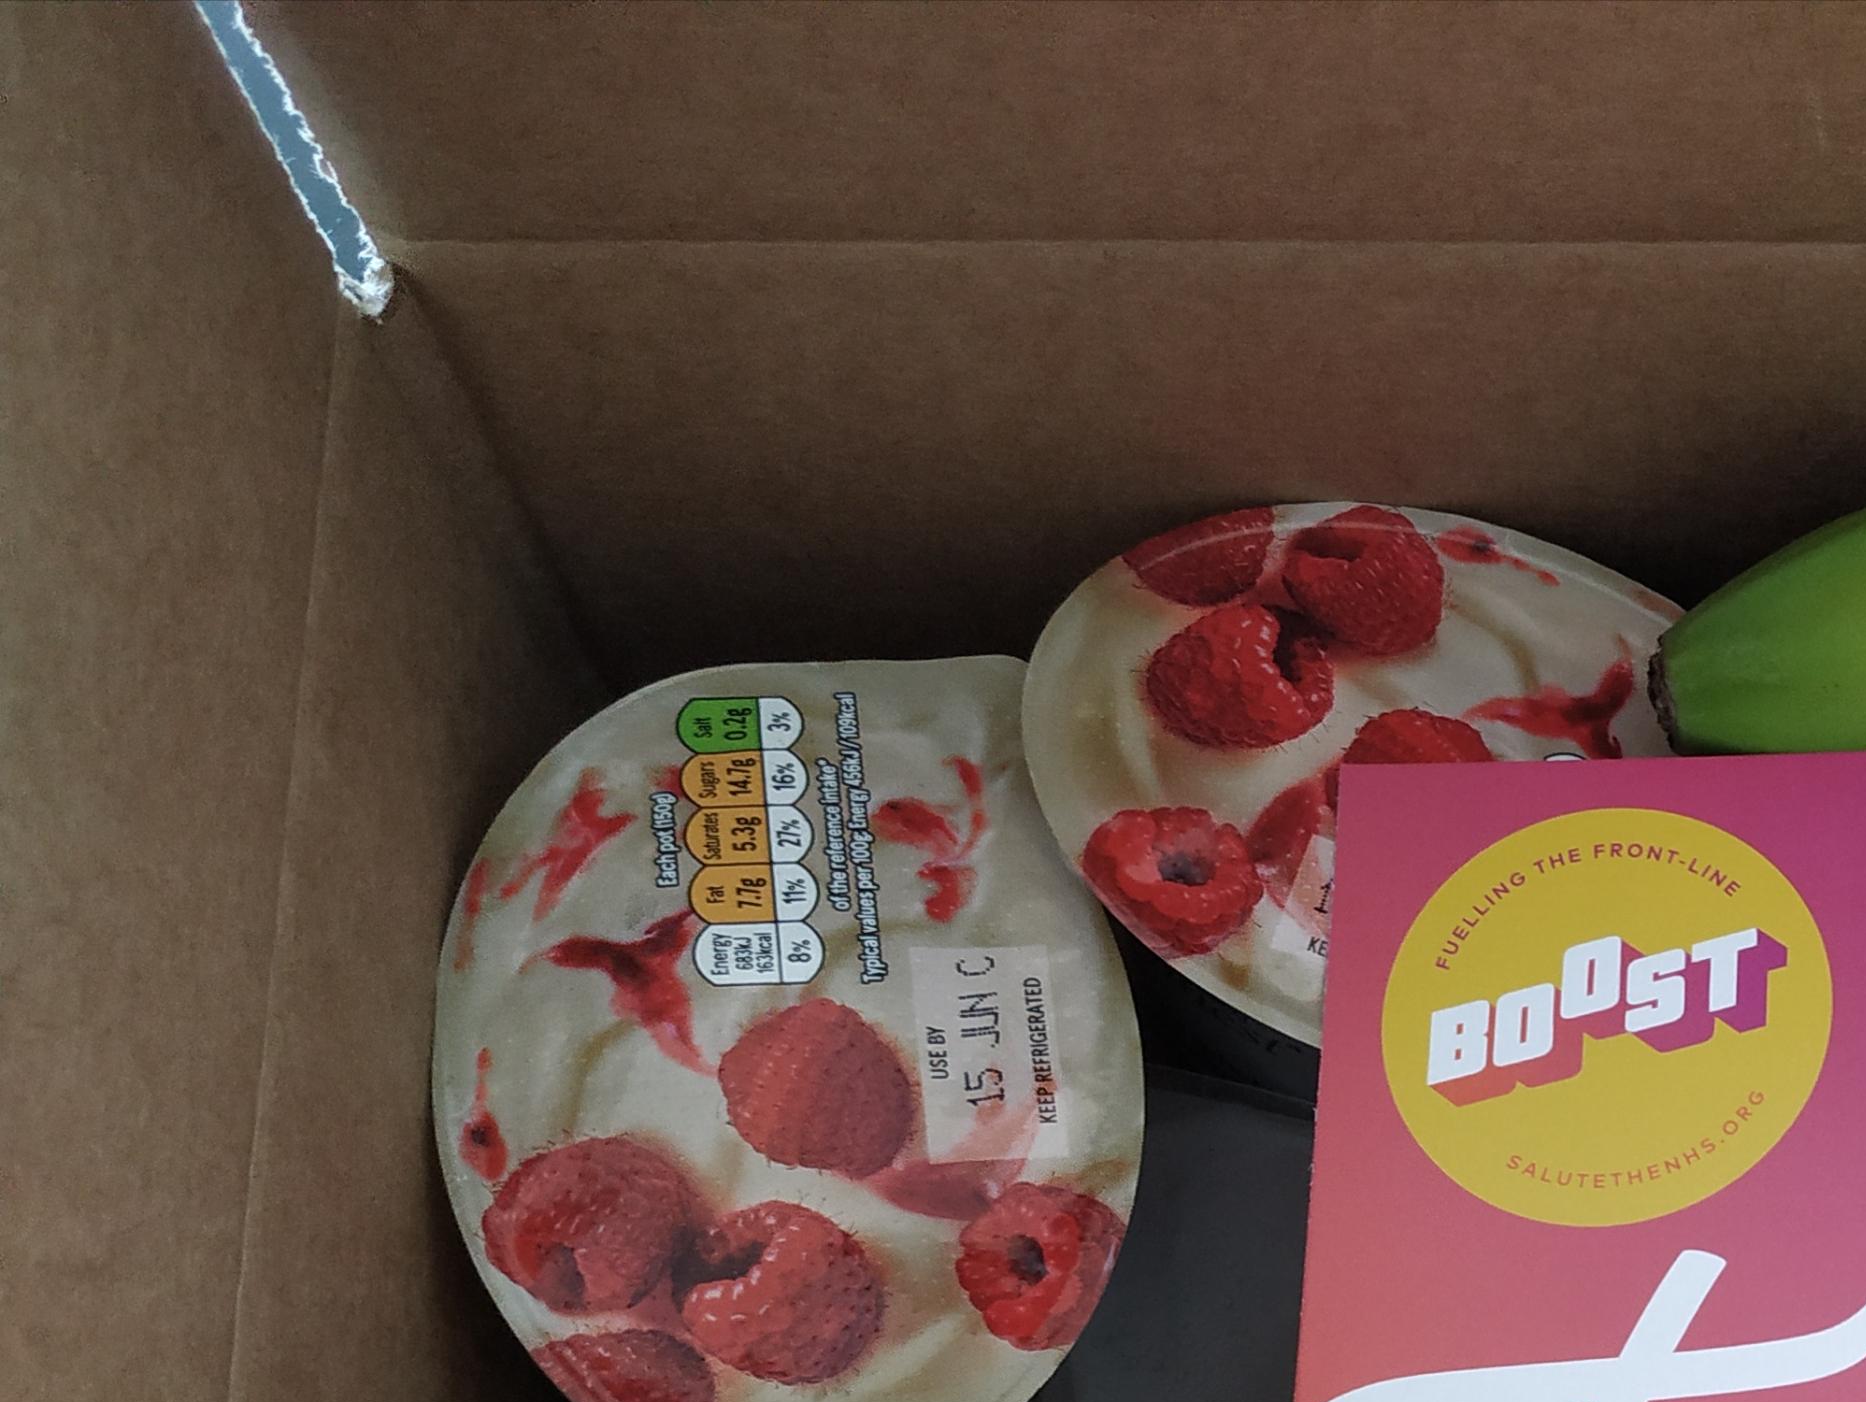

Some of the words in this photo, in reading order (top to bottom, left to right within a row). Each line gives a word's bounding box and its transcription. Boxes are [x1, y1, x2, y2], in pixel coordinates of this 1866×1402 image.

[690, 716, 715, 739] Salt
[719, 706, 756, 741] 0.2g
[764, 711, 792, 733] 3%
[833, 691, 860, 739] 109kcal
[694, 760, 722, 799] Sugars
[723, 756, 760, 797] 14.7g
[769, 761, 798, 792] 16%
[838, 747, 865, 788] 456kJ
[648, 790, 679, 829] (150g)
[842, 786, 873, 830] Energy
[653, 827, 680, 853] pot
[696, 811, 723, 861] Saturates
[728, 815, 765, 853] 5.3g
[774, 818, 803, 848] 27%
[819, 804, 848, 870] reference
[655, 852, 680, 887] Each
[826, 869, 849, 894] the
[854, 864, 878, 890] per
[703, 884, 726, 904] Fat
[733, 876, 770, 910] 7.7g
[778, 877, 809, 905] 11%
[829, 892, 851, 911] of
[1434, 871, 1527, 970] FUELLING
[1532, 847, 1583, 875] THE
[1593, 841, 1741, 897] FRONT-LINE
[852, 889, 879, 934] values
[705, 931, 736, 977] Energy
[731, 935, 756, 971] 683kJ
[751, 931, 777, 975] 163kcal
[784, 938, 814, 964] 8%
[856, 932, 889, 982] Typical
[953, 955, 996, 977] C
[924, 1025, 947, 1045] BY
[956, 990, 1001, 1049] JUN
[1021, 976, 1053, 1084] REFRIGERATED
[1427, 928, 1787, 1106] BOOST
[926, 1049, 950, 1080] USE
[962, 1067, 1005, 1107] 15
[1033, 1085, 1058, 1124] KEEP
[1505, 1089, 1766, 1189] SALUTETHENHS.ORG
